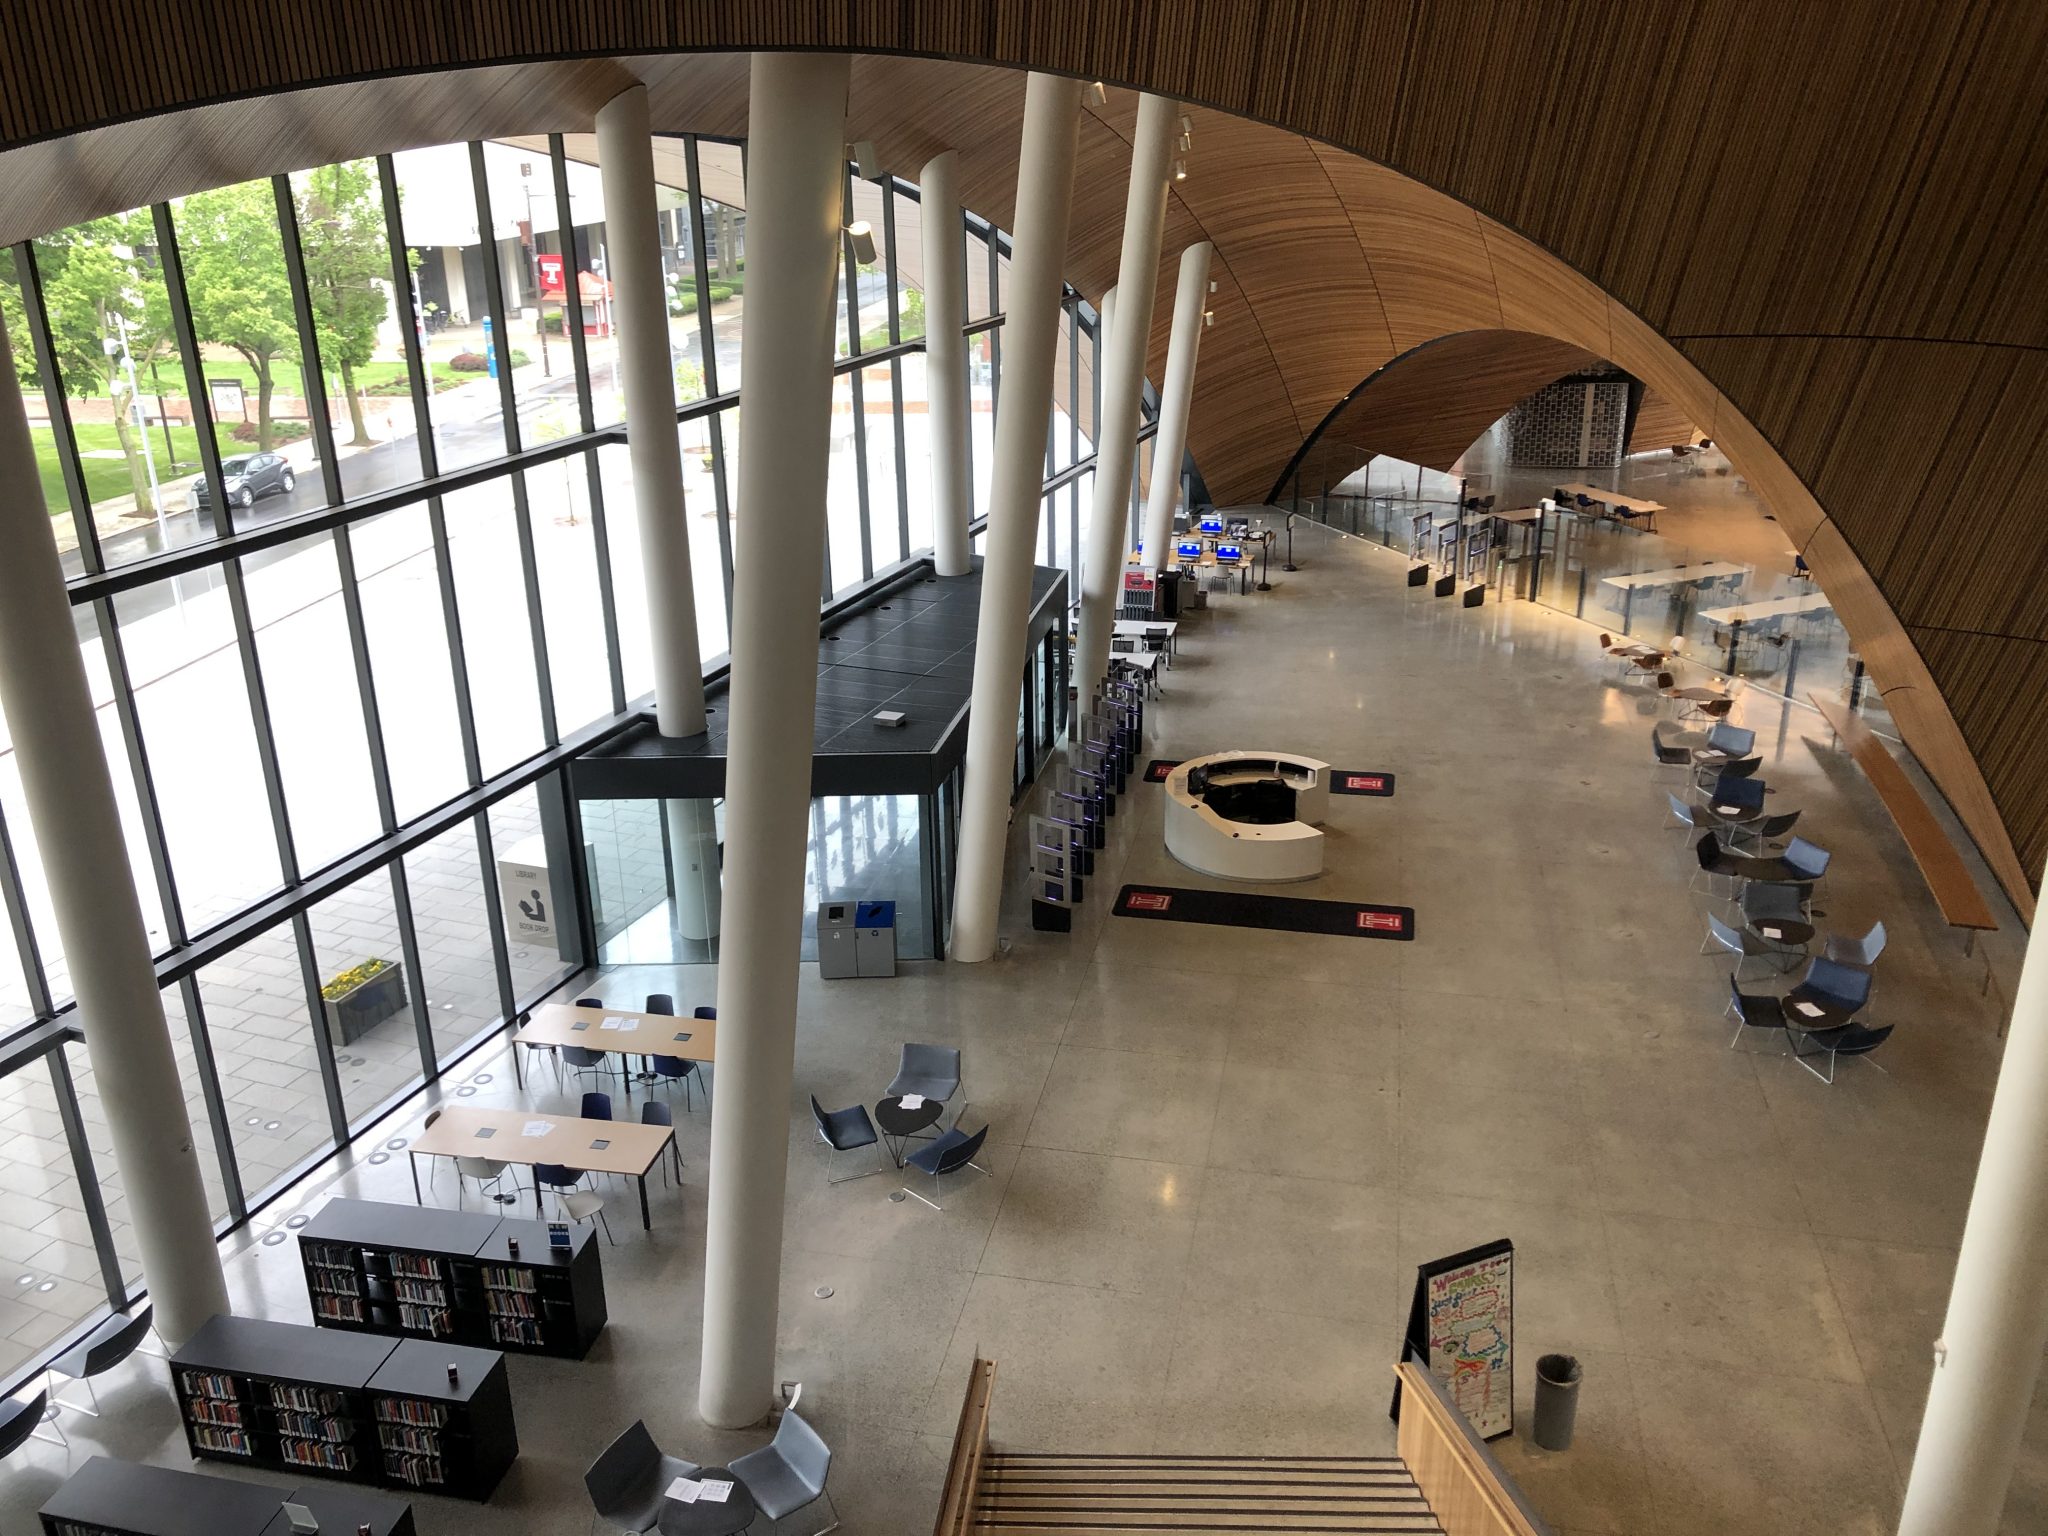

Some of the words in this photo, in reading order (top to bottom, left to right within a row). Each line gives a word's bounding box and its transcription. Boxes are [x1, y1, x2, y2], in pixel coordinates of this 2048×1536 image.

[542, 263, 561, 284] T
[515, 870, 536, 880] LIBRARY
[519, 922, 533, 930] BOOK
